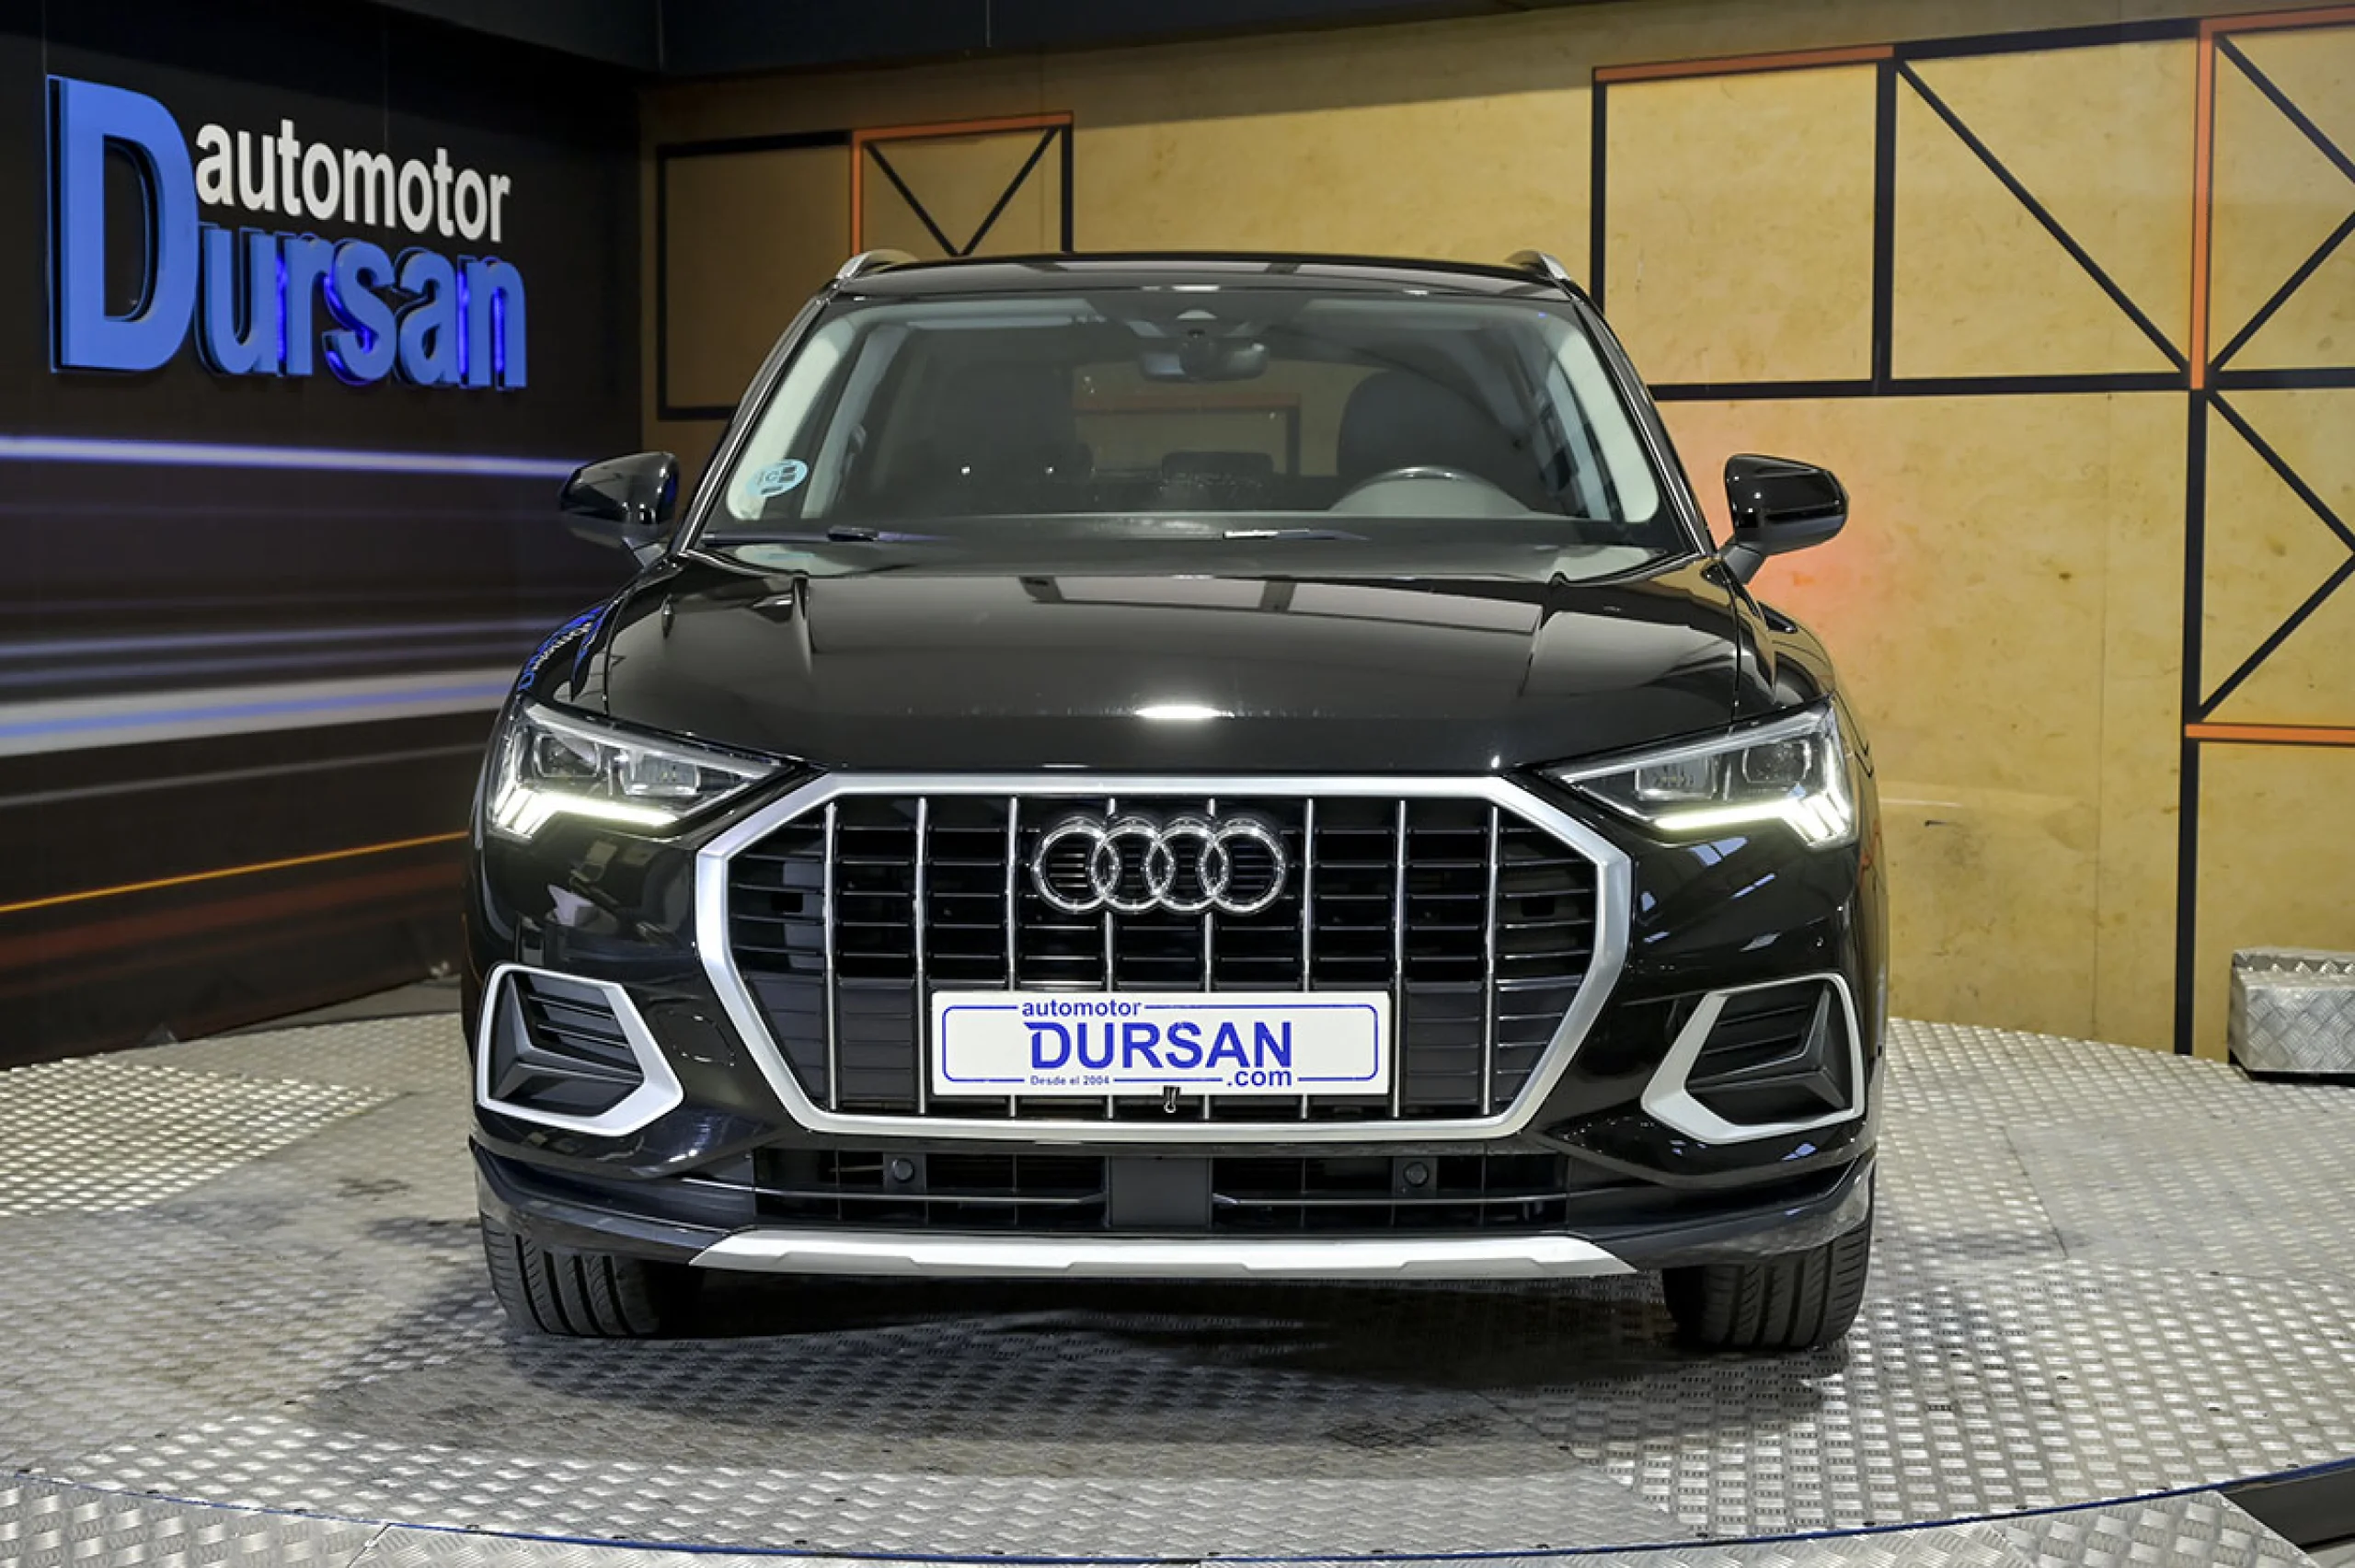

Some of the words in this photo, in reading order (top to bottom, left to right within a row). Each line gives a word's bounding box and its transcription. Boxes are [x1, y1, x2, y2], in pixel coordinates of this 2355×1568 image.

[195, 119, 511, 243] automotor
[47, 74, 527, 391] Dursan
[1022, 999, 1142, 1017] automotor
[1023, 1022, 1292, 1069] DURSAN
[1226, 1070, 1292, 1088] .com
